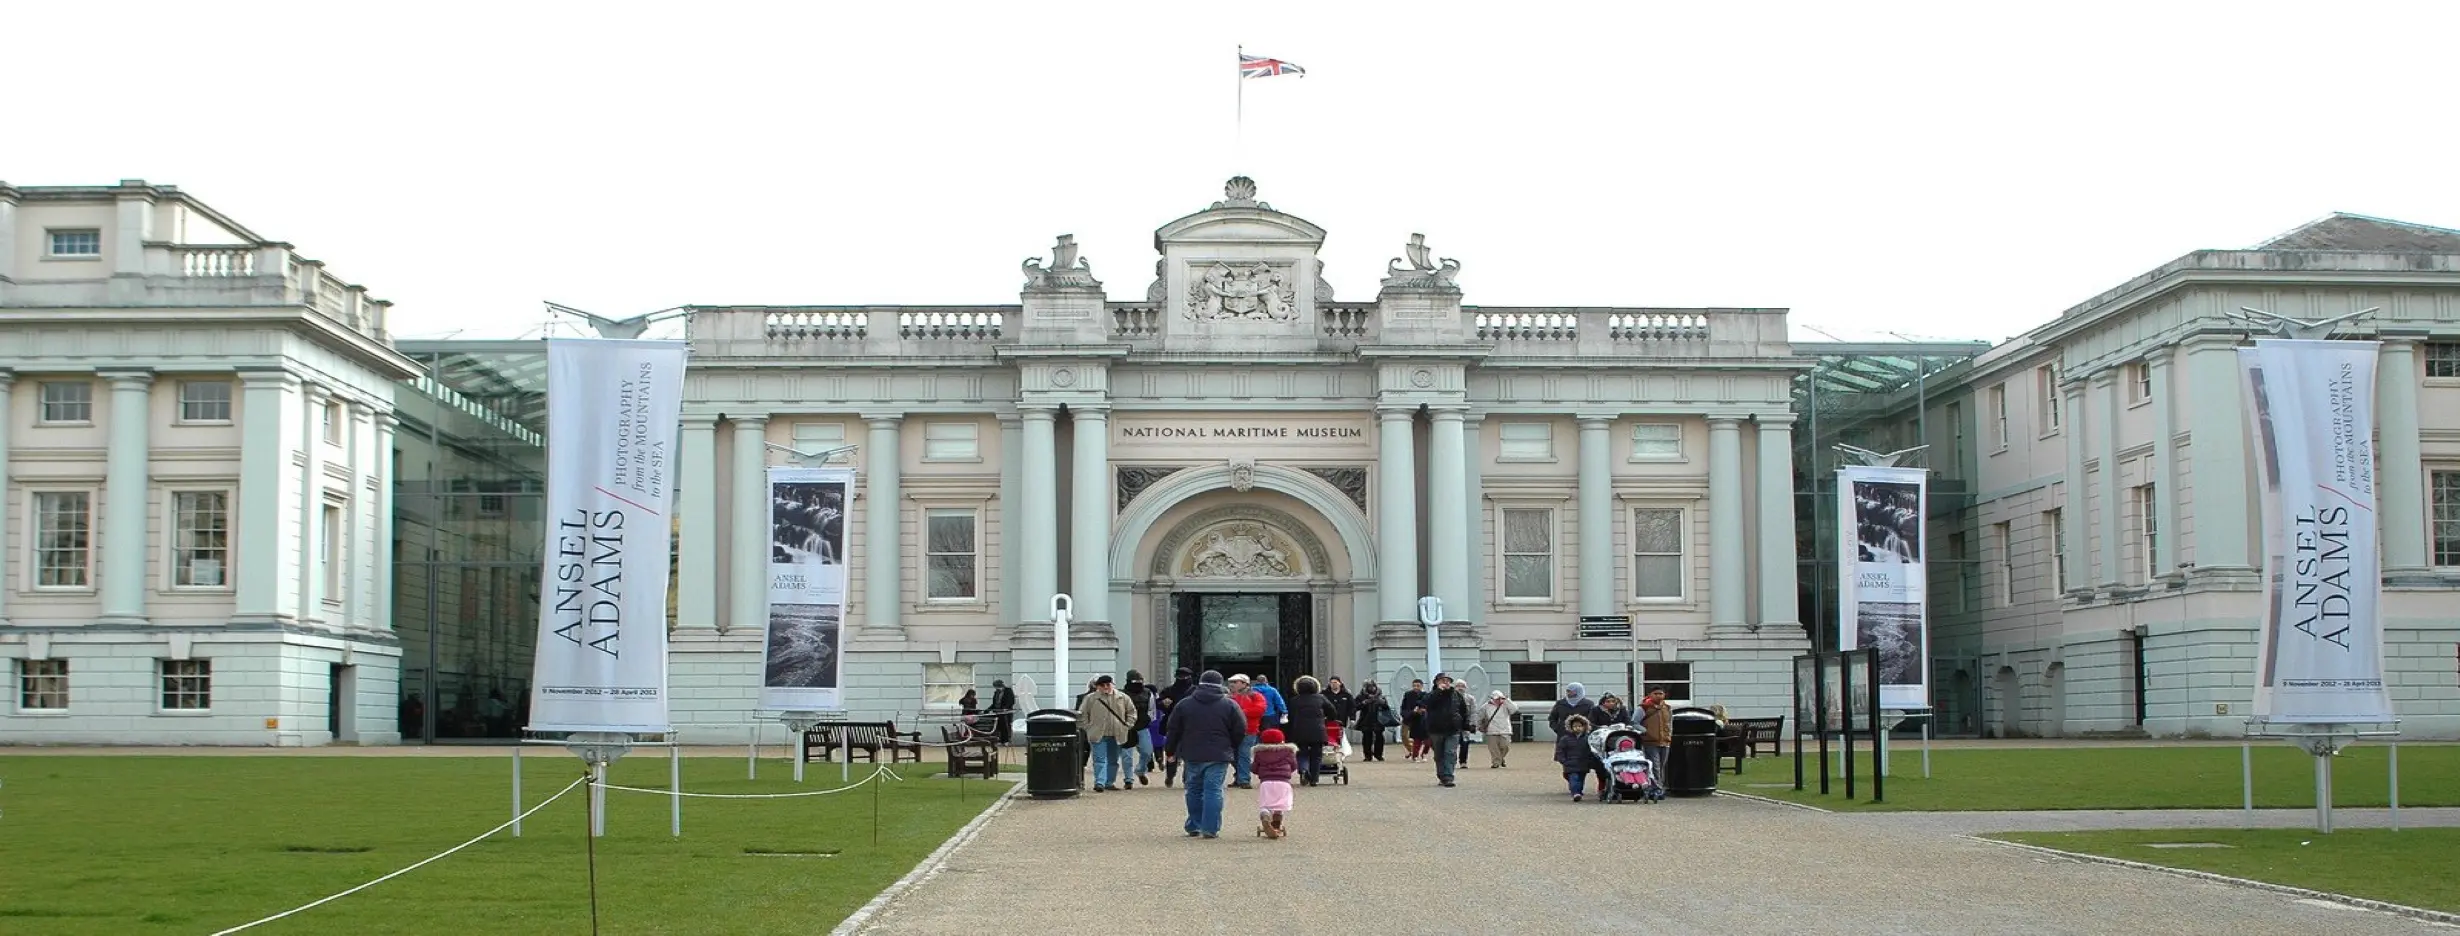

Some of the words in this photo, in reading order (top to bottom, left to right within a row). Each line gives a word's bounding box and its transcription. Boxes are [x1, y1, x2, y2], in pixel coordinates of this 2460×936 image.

[635, 362, 652, 446] MOUNTAINS
[2341, 362, 2354, 446] MOUNTAINS
[615, 379, 633, 486] PHOTOGRAPHY
[1123, 427, 1207, 437] NATIONAL
[1213, 427, 1288, 437] MARITIME
[1296, 427, 1362, 437] MUSEUM
[2329, 379, 2345, 482] PHOTOGRAPHY
[634, 449, 646, 464] the
[652, 440, 664, 468] SEA
[2360, 439, 2369, 466] SEA
[632, 465, 646, 493] from
[650, 470, 662, 486] the
[2349, 465, 2358, 491] from
[2360, 467, 2371, 482] the
[651, 487, 661, 498] to
[553, 508, 588, 647] ANSEL
[588, 510, 625, 660] ADAMS
[774, 574, 807, 582] ANSEL
[1858, 580, 1890, 588] ADAMS
[2294, 504, 2318, 641] ANSEL
[2319, 506, 2350, 653] ADAMS
